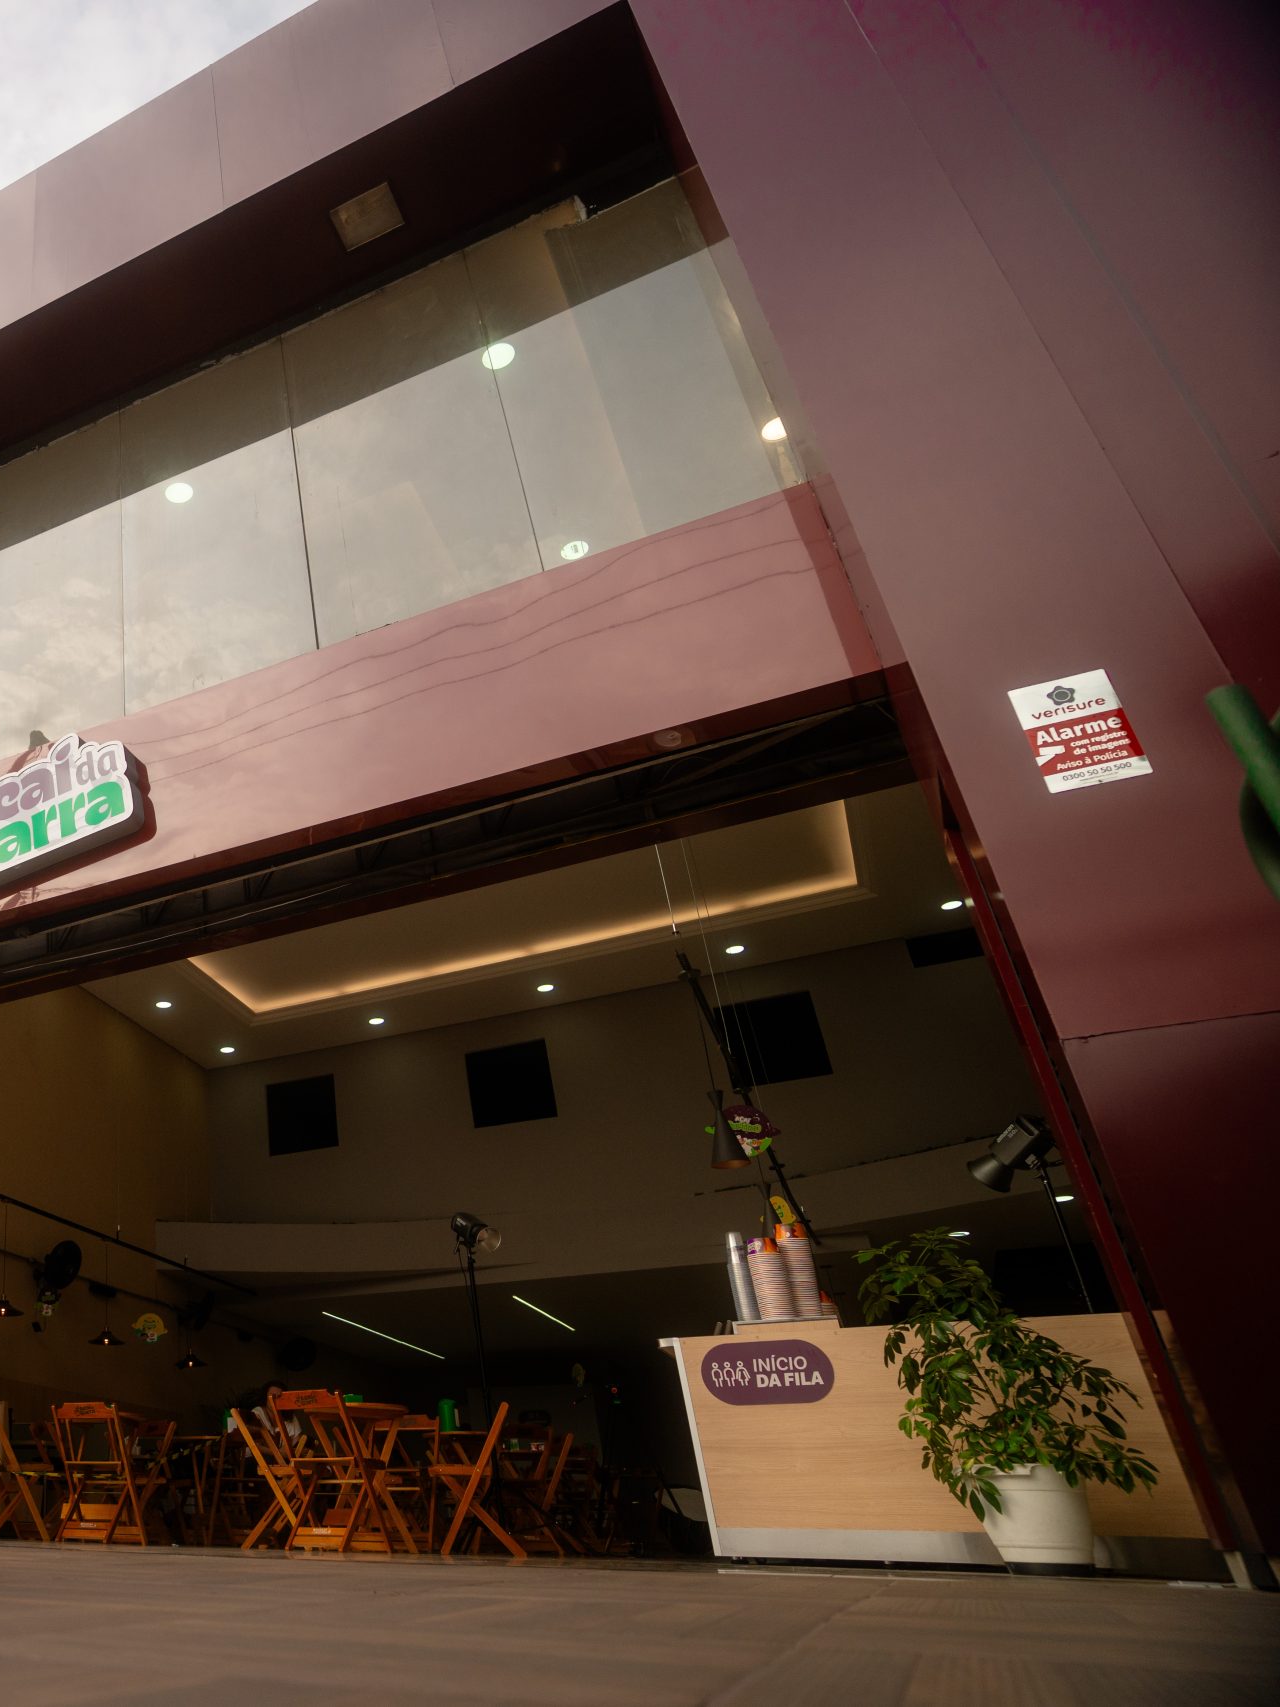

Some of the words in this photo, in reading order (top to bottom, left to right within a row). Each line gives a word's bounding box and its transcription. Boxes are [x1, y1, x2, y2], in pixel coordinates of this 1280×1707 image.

[1032, 698, 1106, 720] verisure
[1037, 716, 1122, 746] Alarme
[1070, 739, 1090, 747] com
[1073, 747, 1087, 755] de
[1087, 738, 1131, 752] imagens
[76, 750, 118, 786] da
[1056, 760, 1083, 771] Aviso
[1062, 771, 1086, 781] 0300
[1087, 768, 1099, 777] 50
[1100, 765, 1113, 774] 50
[1113, 761, 1132, 771] 500
[753, 1354, 808, 1373] INÍCIO
[756, 1373, 782, 1388] DA
[784, 1371, 824, 1387] FILA
